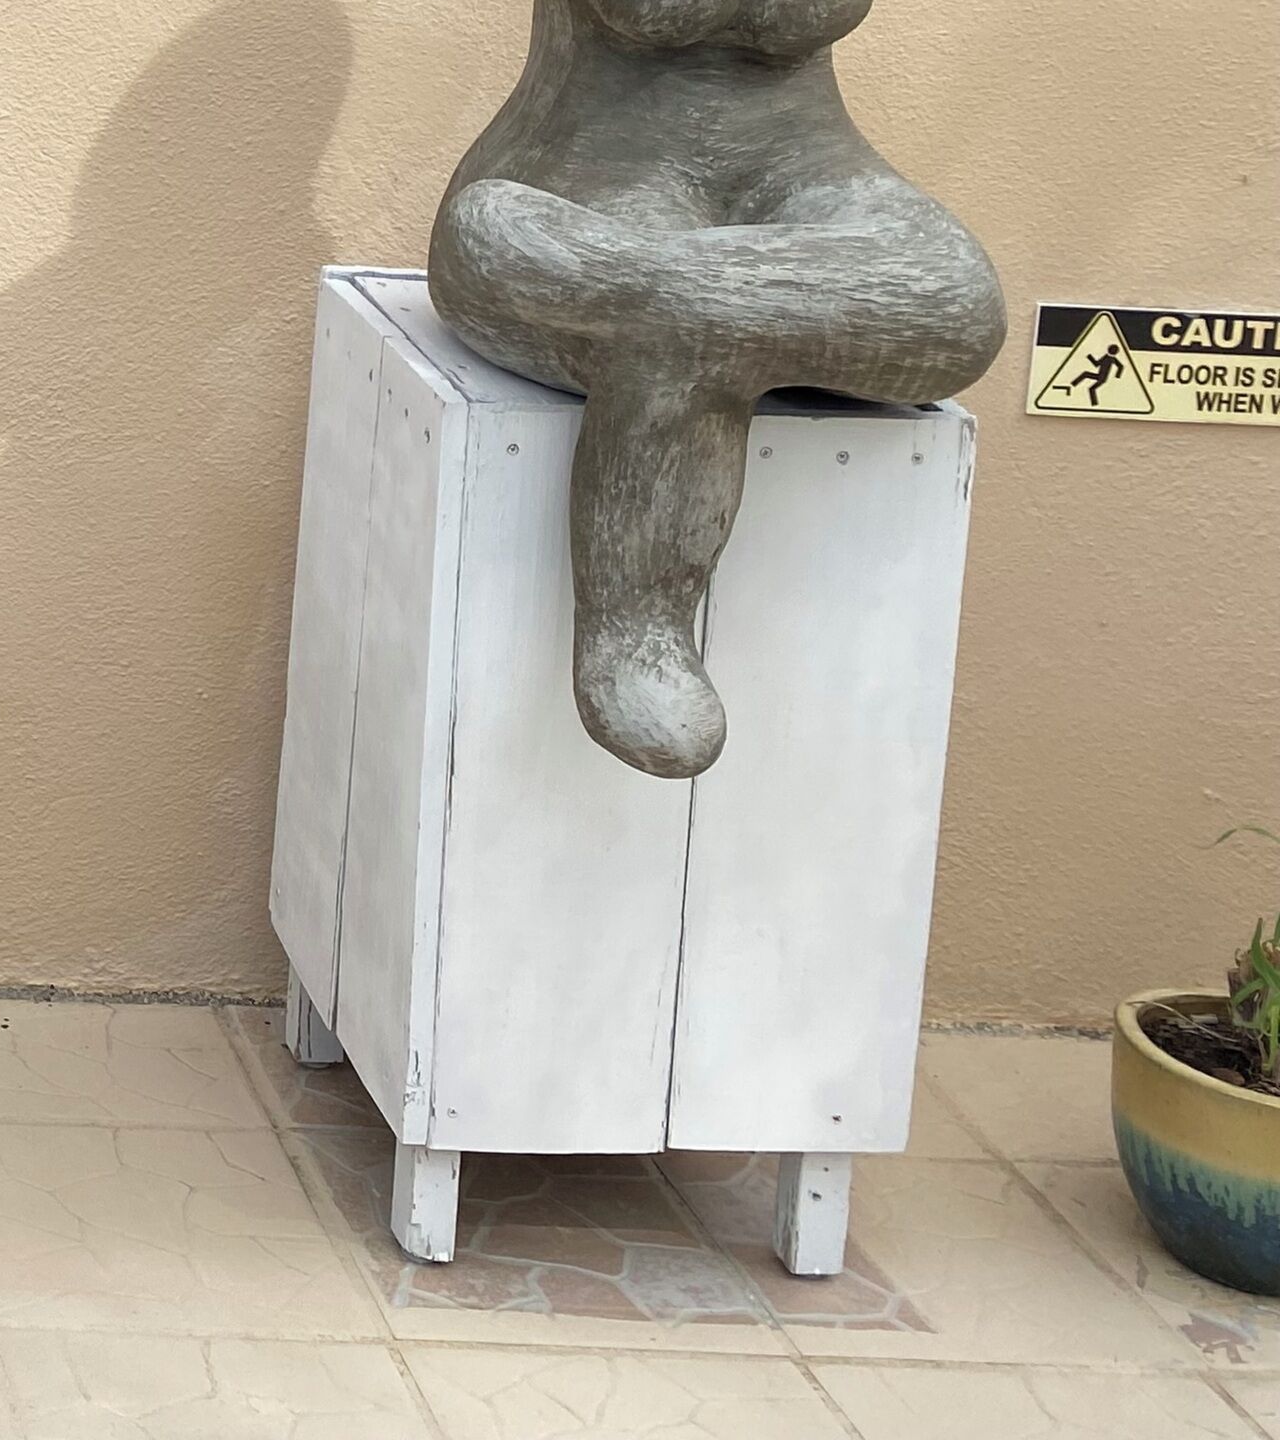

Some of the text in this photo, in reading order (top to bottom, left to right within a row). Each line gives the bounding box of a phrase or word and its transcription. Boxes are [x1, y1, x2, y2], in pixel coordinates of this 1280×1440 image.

[1148, 363, 1228, 387] FLOOR
[1234, 366, 1255, 388] IS
[1196, 391, 1264, 414] WHEN
